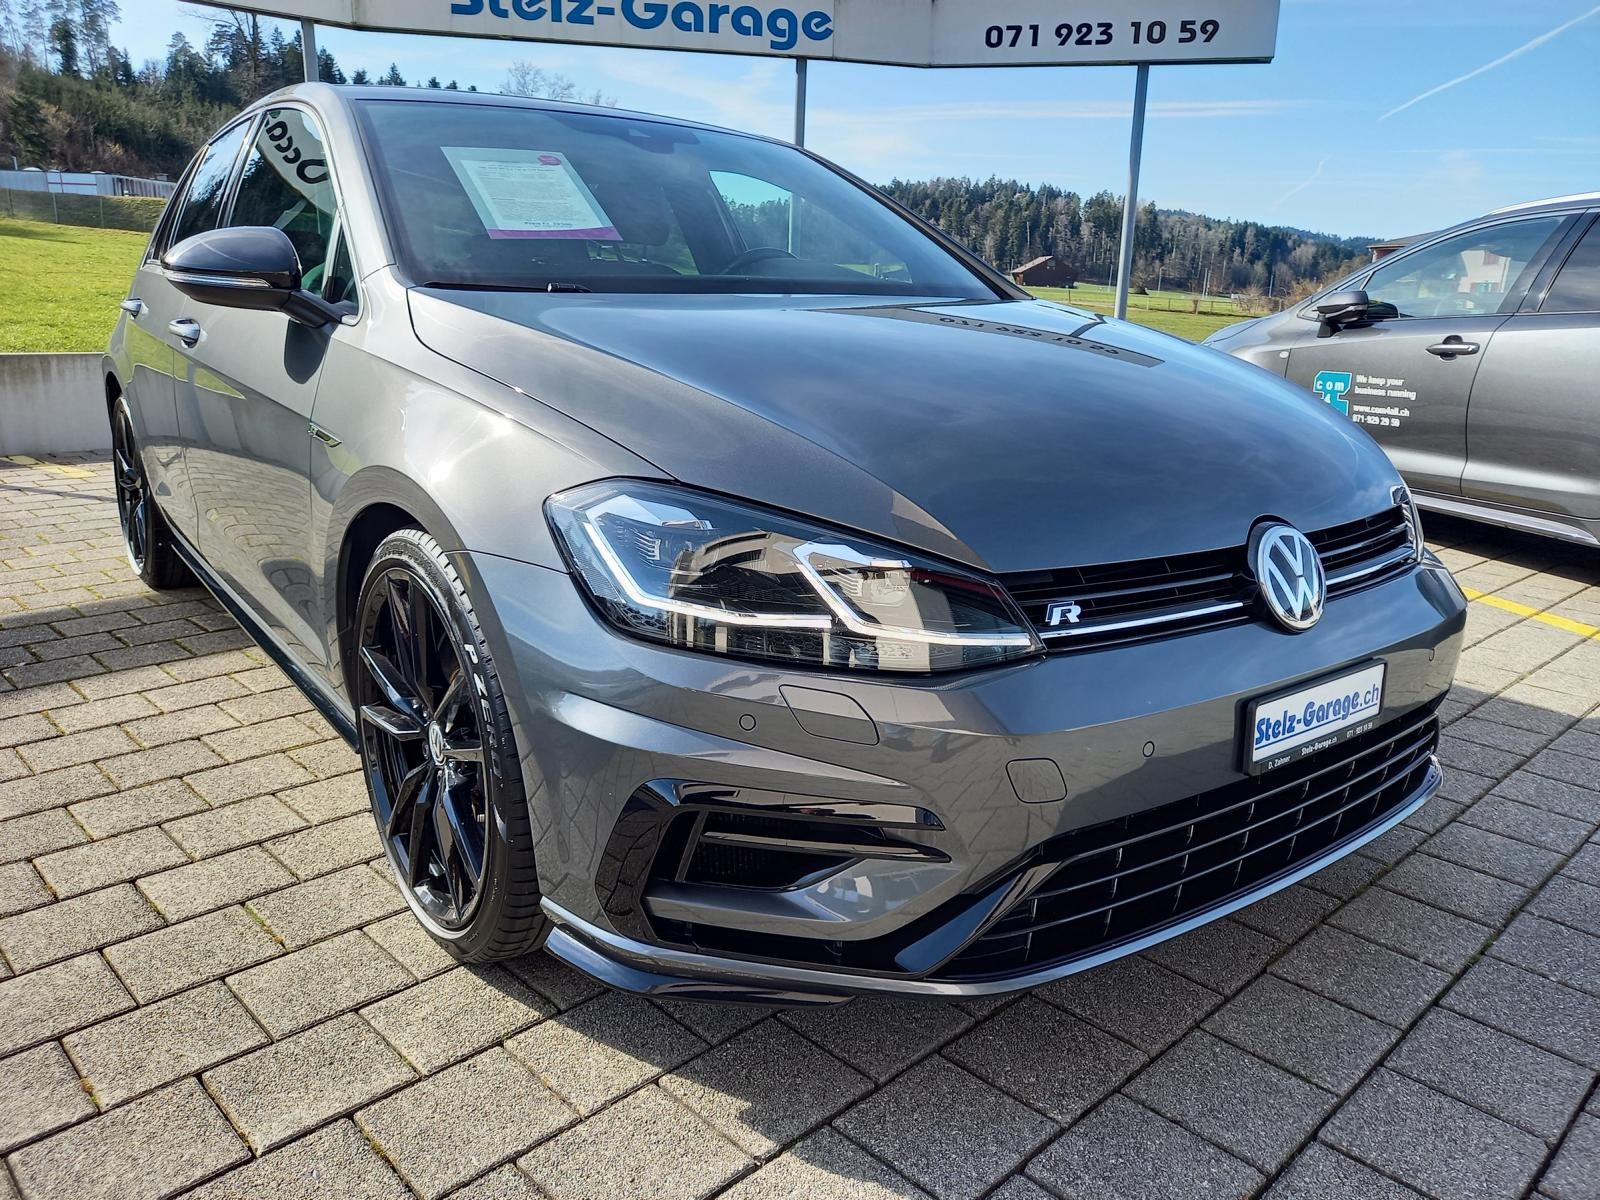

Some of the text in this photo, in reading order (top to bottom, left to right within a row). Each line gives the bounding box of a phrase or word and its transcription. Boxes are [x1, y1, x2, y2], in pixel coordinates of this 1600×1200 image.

[985, 19, 1220, 48] 071 923 10 59
[1316, 380, 1345, 391] com
[1387, 389, 1417, 400] running
[1045, 600, 1081, 626] R
[1255, 684, 1380, 745] Stelz-Garage.ch
